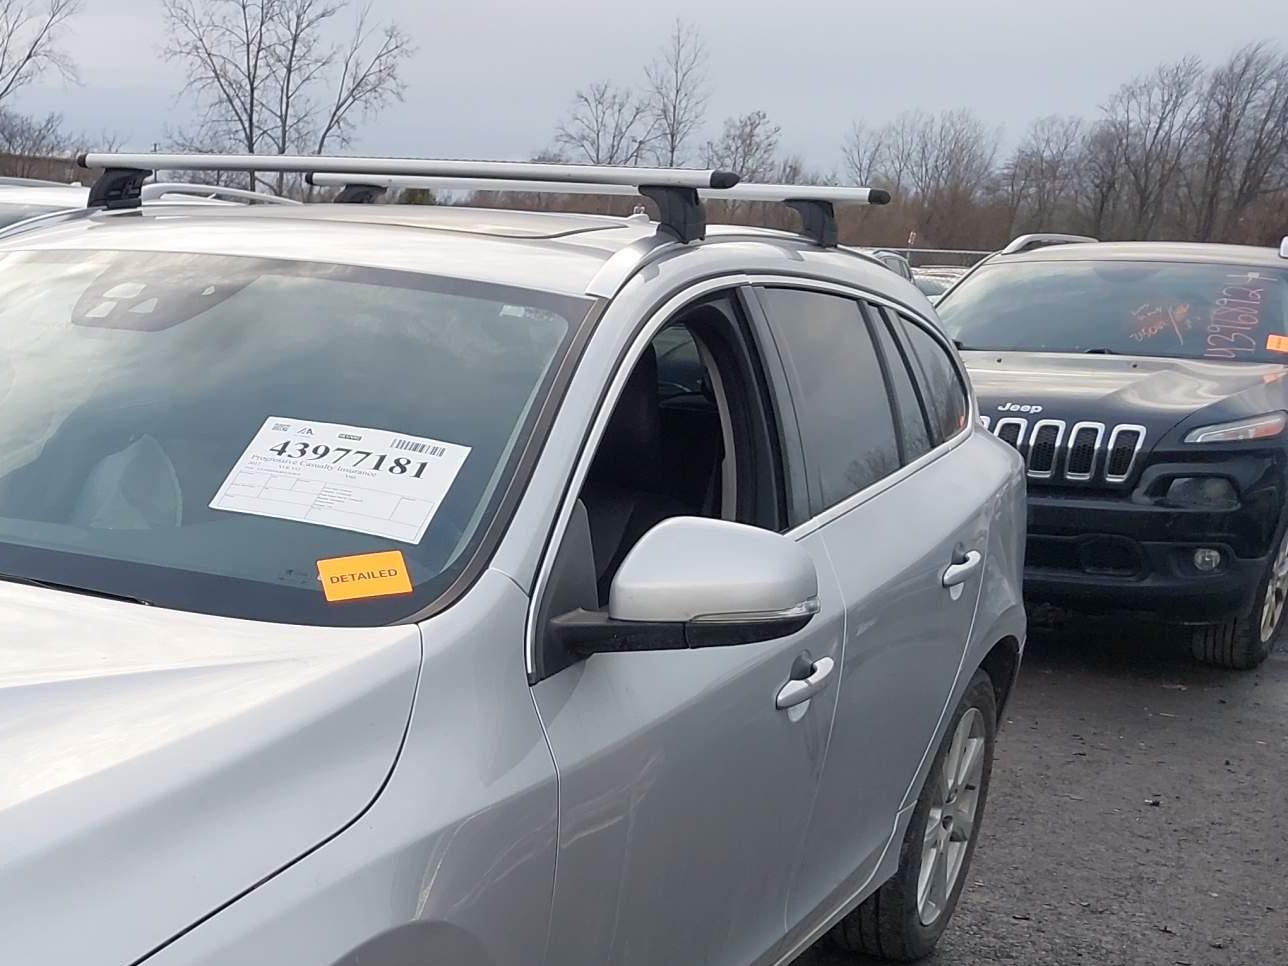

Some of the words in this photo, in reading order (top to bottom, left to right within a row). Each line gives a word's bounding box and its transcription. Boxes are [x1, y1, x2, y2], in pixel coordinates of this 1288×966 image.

[996, 402, 1044, 414] Jeep
[268, 438, 430, 480] 43977181
[299, 460, 334, 471] Casualty
[337, 465, 377, 477] Insurance
[329, 567, 399, 585] DETAILED
